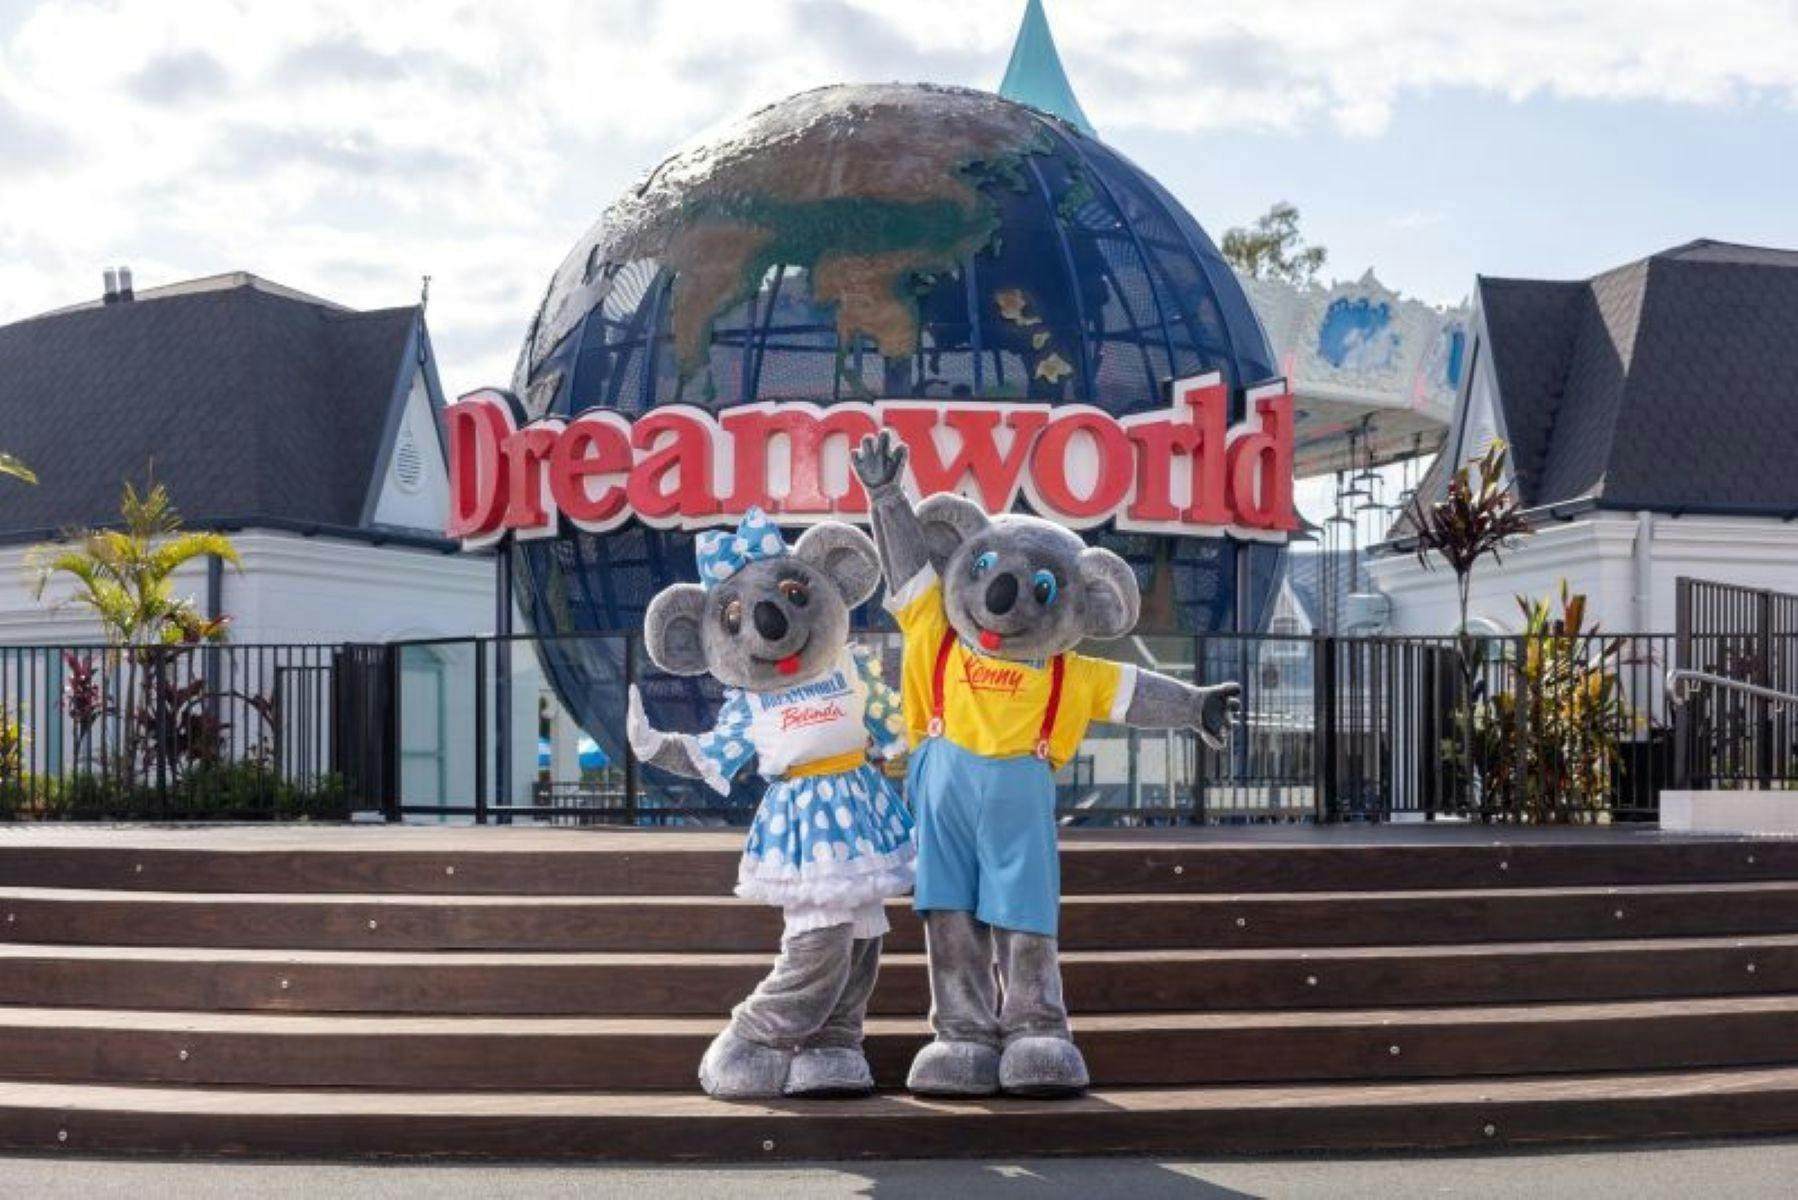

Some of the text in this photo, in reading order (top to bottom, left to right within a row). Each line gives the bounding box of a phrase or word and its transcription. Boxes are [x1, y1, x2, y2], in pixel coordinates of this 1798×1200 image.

[444, 382, 1298, 539] Dreamworld
[961, 655, 1023, 697] Kenny
[780, 702, 846, 730] Belinda
